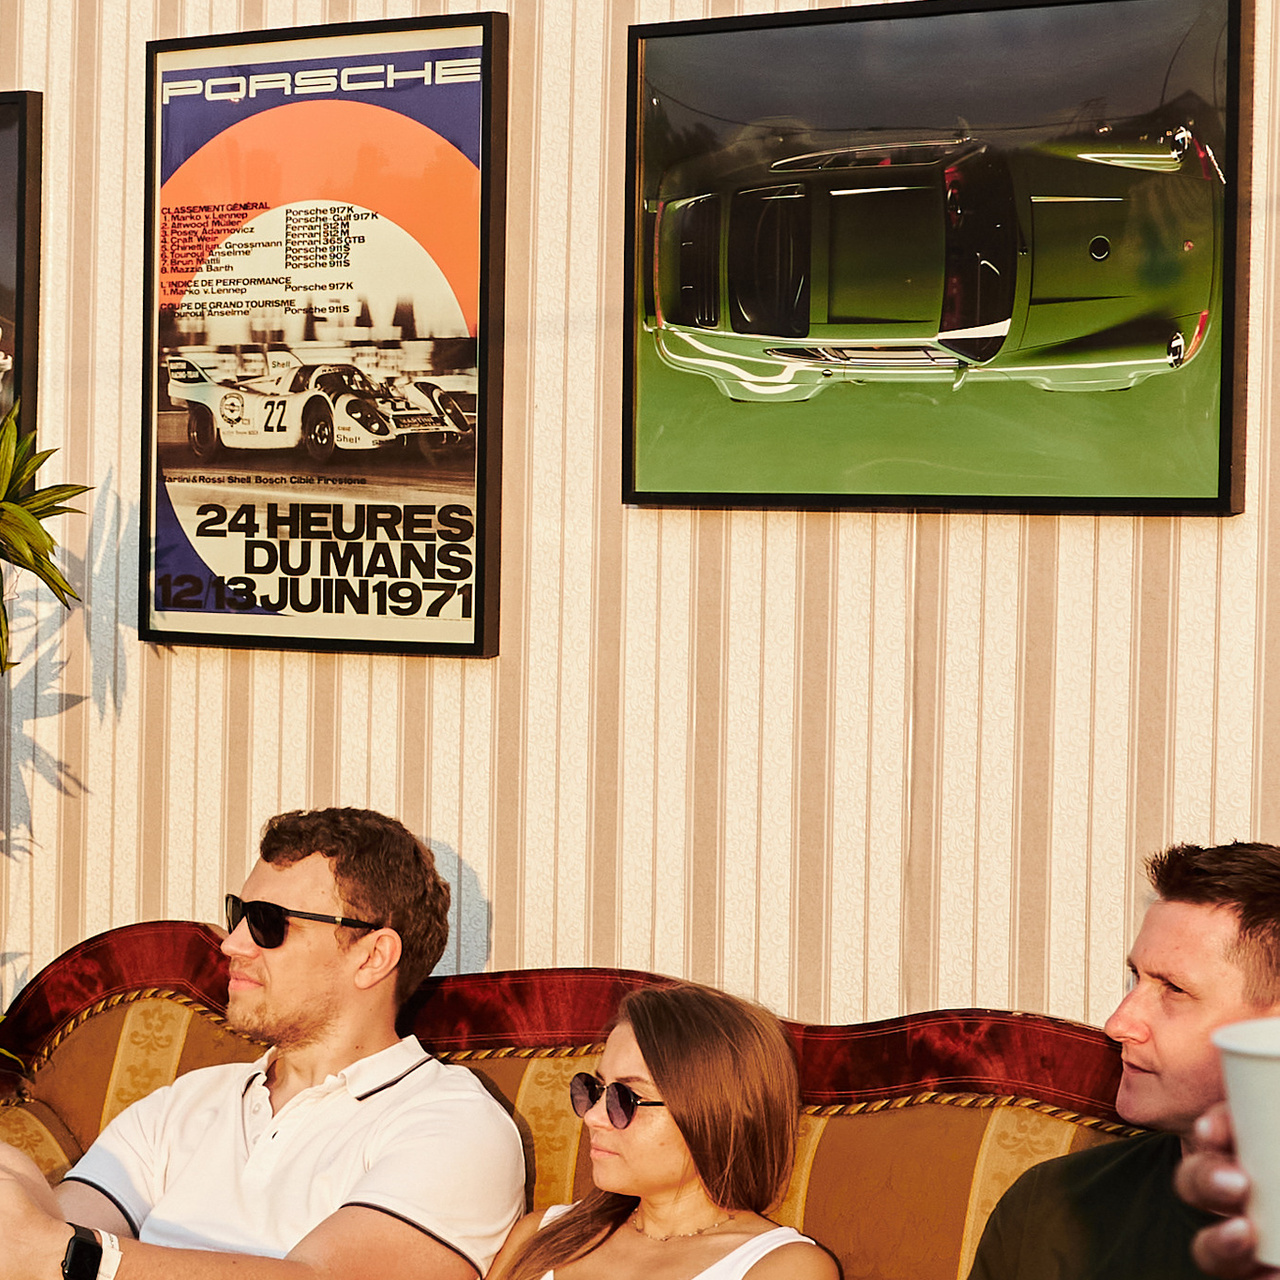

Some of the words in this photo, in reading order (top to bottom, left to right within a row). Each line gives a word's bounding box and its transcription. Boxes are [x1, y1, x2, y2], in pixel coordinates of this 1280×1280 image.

[162, 58, 481, 105] PORSCHE
[161, 205, 224, 216] CLASSEMENT
[286, 207, 328, 216] Porsche
[171, 214, 201, 222] Marko
[286, 223, 322, 232] Ferrari
[286, 231, 322, 239] Ferrari
[225, 241, 282, 250] Grossmann
[286, 238, 322, 247] Ferrari
[322, 237, 343, 246] 365
[286, 245, 328, 254] Porsche
[286, 253, 328, 262] Porsche
[329, 252, 350, 260] 907
[170, 258, 194, 266] Brun
[285, 261, 328, 270] Porsche
[206, 264, 234, 272] Barth
[201, 280, 214, 288] DE
[216, 277, 292, 287] PERFORMANCE
[170, 288, 200, 296] Marko
[284, 283, 328, 292] Porsche
[160, 302, 193, 310] COUPE
[194, 302, 207, 310] DE
[209, 301, 244, 310] GRAND
[244, 300, 296, 308] TOURISME
[284, 306, 327, 315] Porsche
[272, 360, 291, 369] Shell
[264, 400, 287, 432] 22
[227, 476, 252, 484] Shell
[255, 476, 287, 484] Bosch
[195, 504, 260, 538] 24
[267, 503, 474, 542] HEURES
[244, 540, 311, 576] DU
[320, 541, 473, 581] MANS
[260, 577, 370, 615] JUIN
[372, 580, 473, 618] 1971
